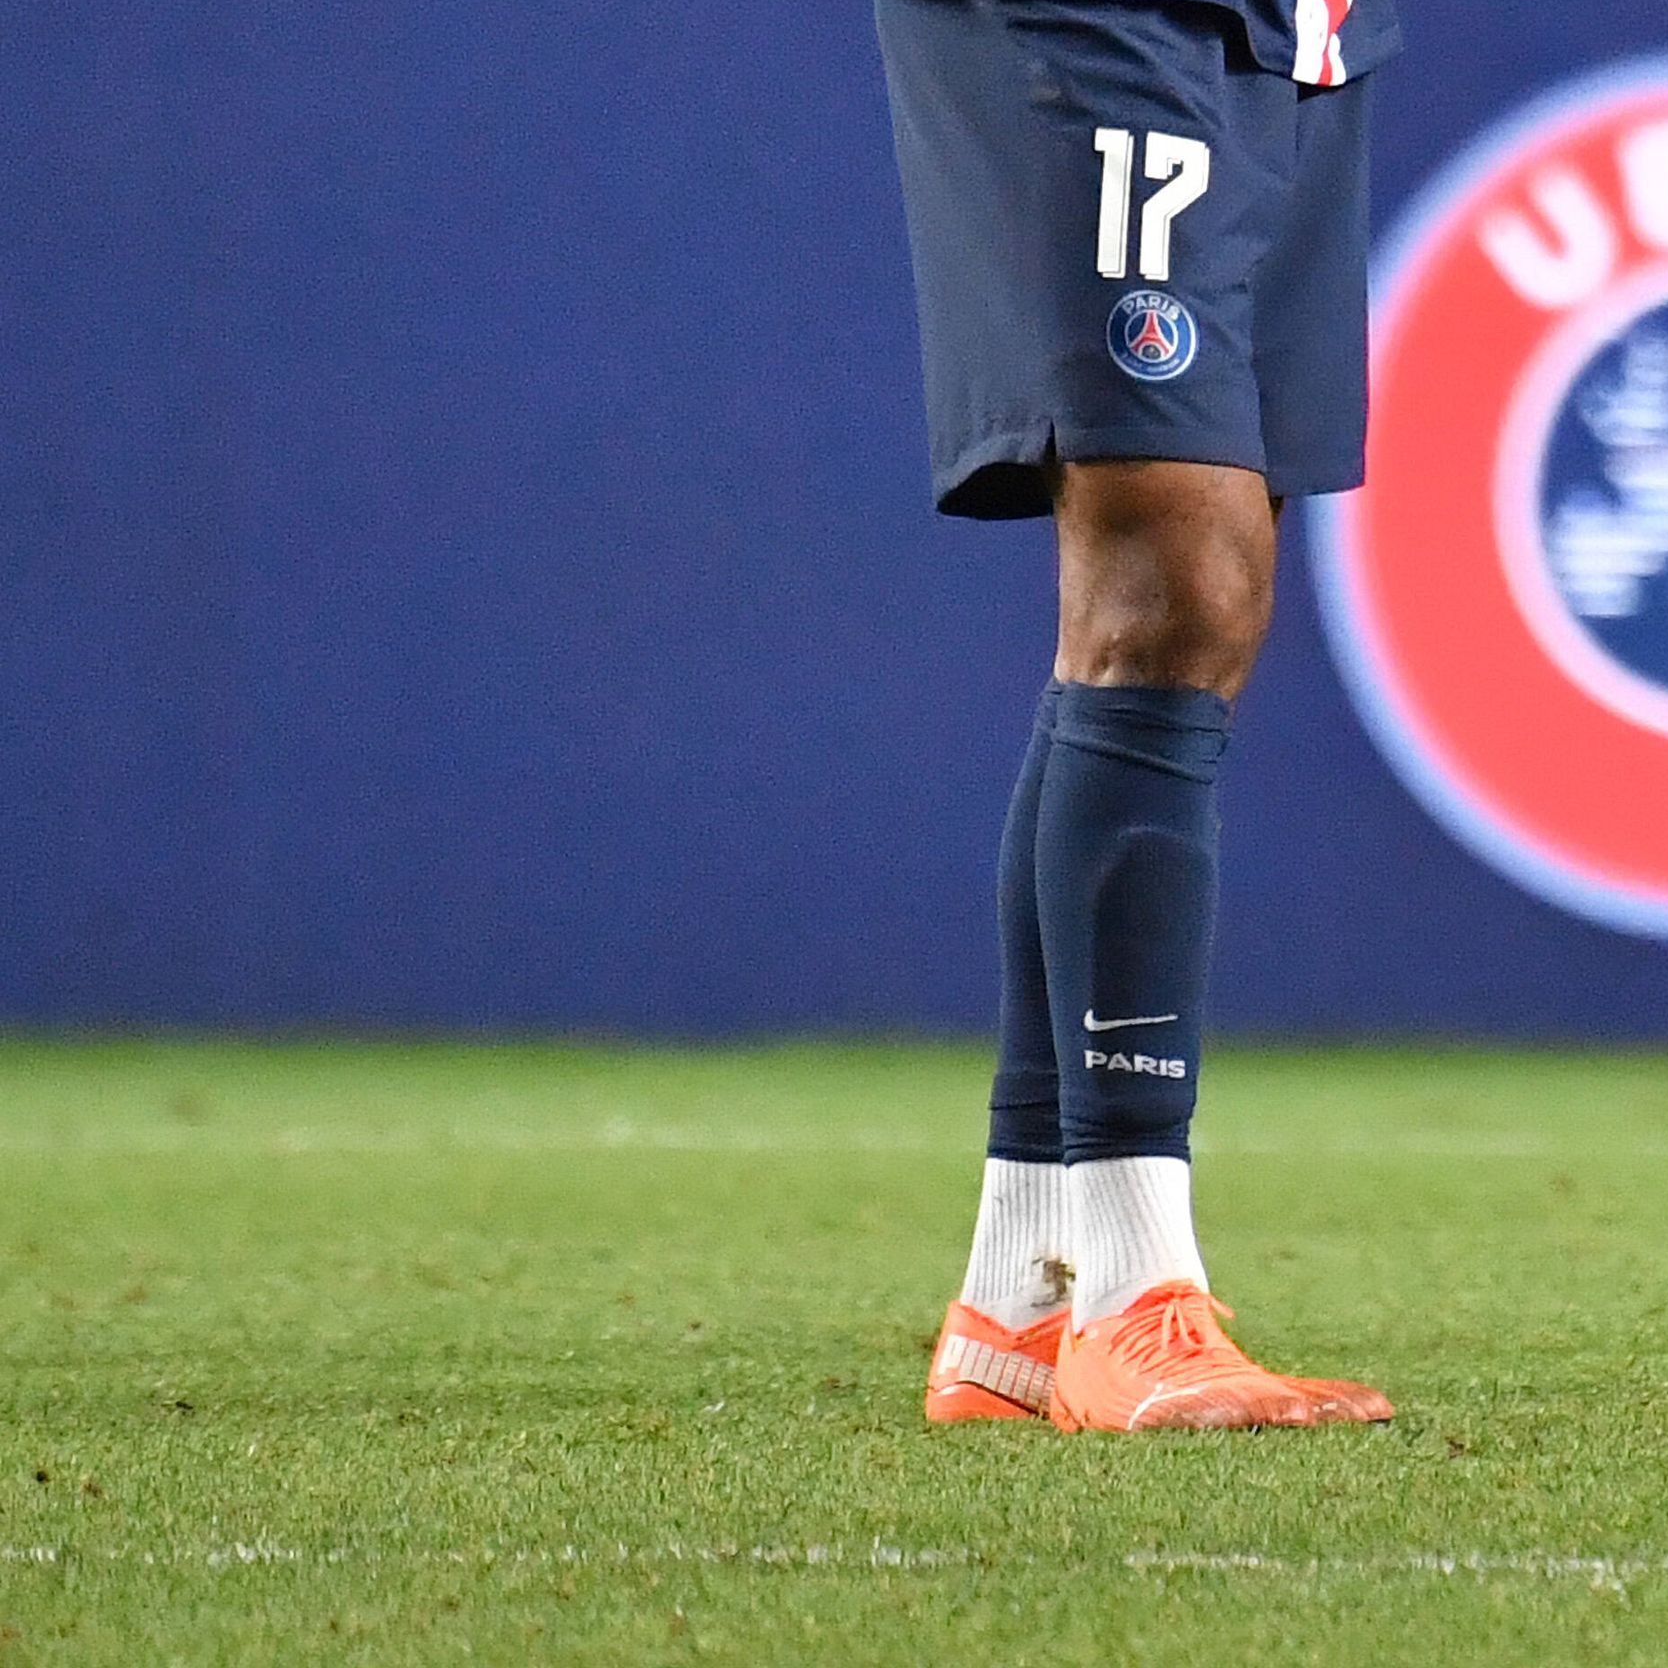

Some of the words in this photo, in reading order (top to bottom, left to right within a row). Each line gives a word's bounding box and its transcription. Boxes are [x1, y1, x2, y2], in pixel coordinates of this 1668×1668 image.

[1094, 127, 1211, 281] 17
[1121, 295, 1182, 322] PARIS
[1083, 1048, 1187, 1080] PARIS
